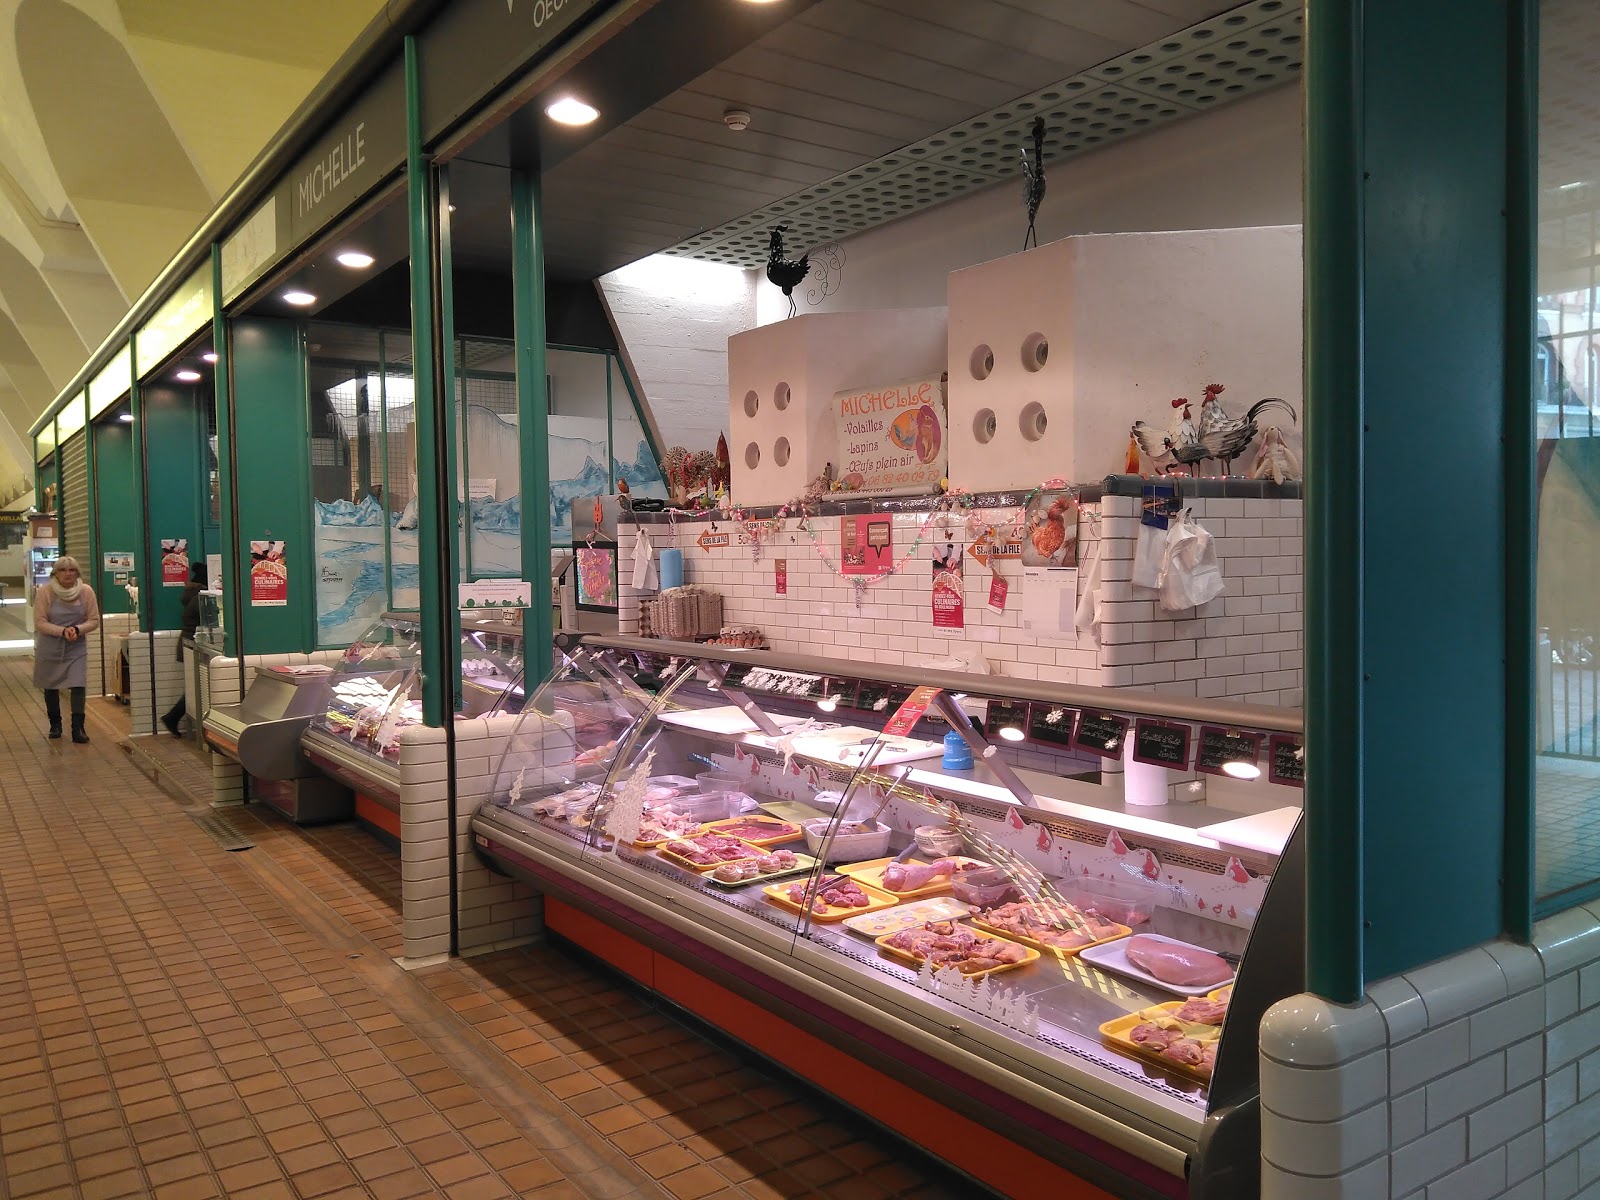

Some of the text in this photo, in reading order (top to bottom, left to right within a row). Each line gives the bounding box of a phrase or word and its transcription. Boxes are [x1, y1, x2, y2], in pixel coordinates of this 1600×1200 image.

[298, 122, 366, 218] MICHELLE
[841, 383, 931, 417] MICHELLE
[844, 419, 884, 435] -Volailles
[847, 441, 879, 455] -Lapins
[876, 457, 898, 472] plein
[901, 454, 914, 466] air
[895, 473, 909, 482] 40
[703, 537, 711, 545] SENS
[993, 545, 1000, 555] DE
[1001, 544, 1008, 554] LA
[1009, 544, 1020, 554] FILE
[934, 598, 961, 606] CULINAIRES
